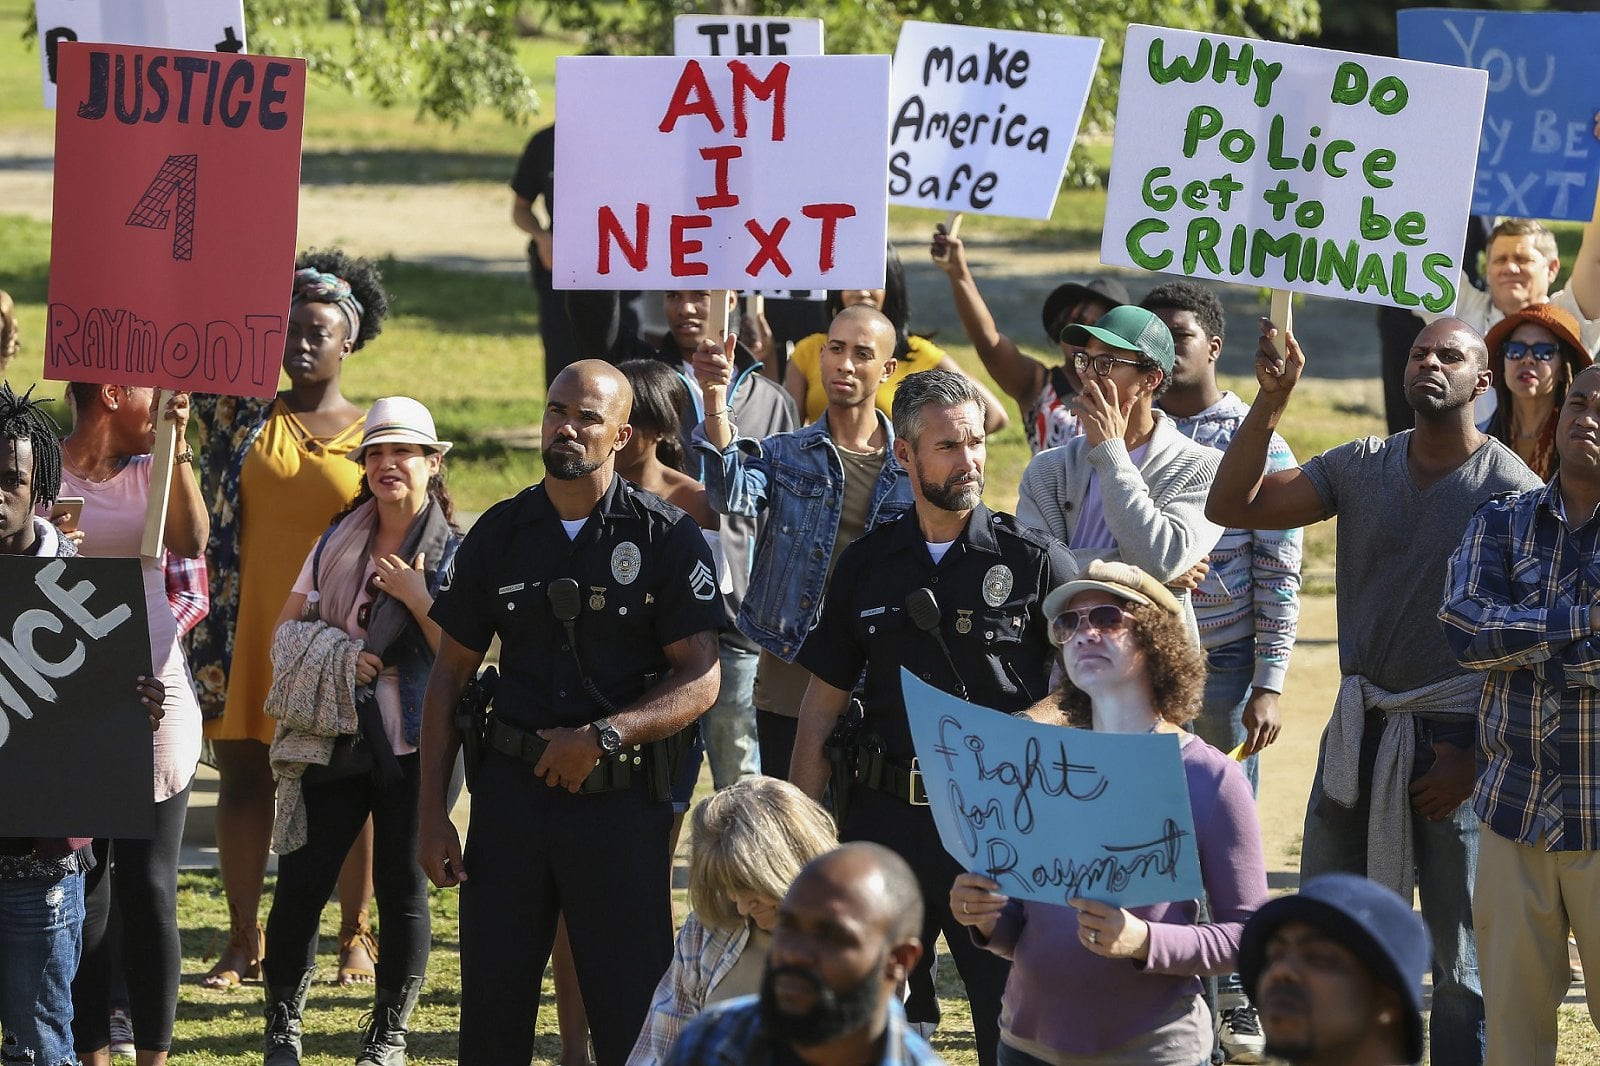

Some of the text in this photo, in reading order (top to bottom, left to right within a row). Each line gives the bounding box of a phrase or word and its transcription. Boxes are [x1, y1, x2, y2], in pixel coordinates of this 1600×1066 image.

[698, 22, 791, 56] THE
[1148, 37, 1409, 115] WHY DO
[1443, 16, 1556, 97] YOU
[76, 51, 292, 131] JUSTICE
[659, 60, 790, 141] AM
[891, 95, 1050, 153] America
[1531, 109, 1589, 159] BE
[125, 153, 198, 262] 4
[696, 145, 742, 210] I
[888, 151, 998, 209] Safe
[1264, 180, 1325, 229] to
[1360, 196, 1428, 246] be
[597, 203, 856, 277] NEXT
[1126, 217, 1456, 314] CRIMINALS
